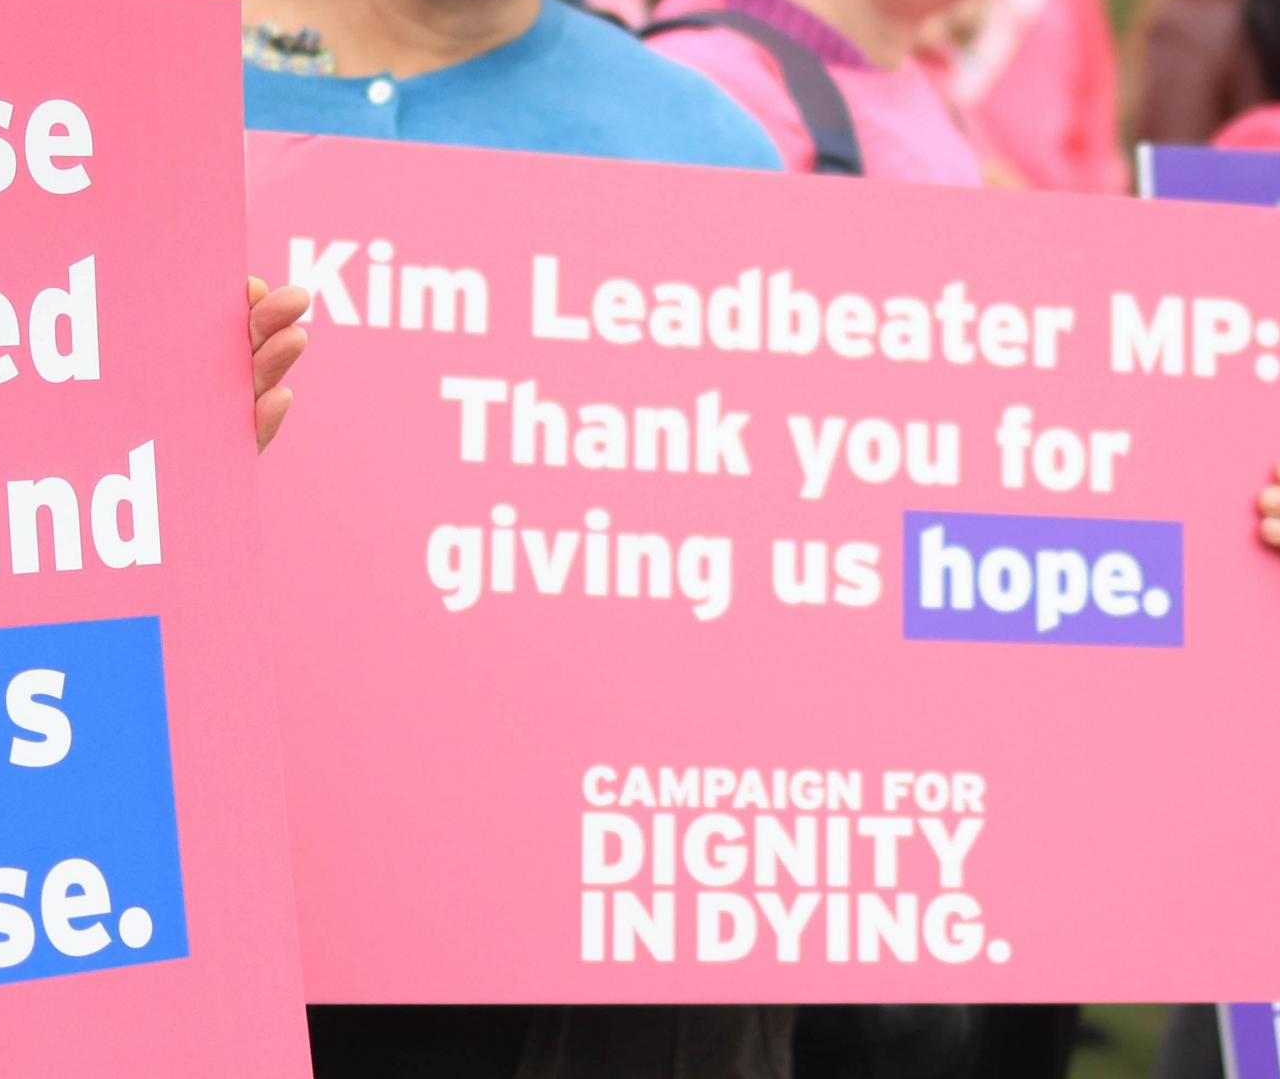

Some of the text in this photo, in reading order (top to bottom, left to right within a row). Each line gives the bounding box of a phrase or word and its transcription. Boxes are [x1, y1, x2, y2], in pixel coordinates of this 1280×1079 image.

[283, 238, 489, 333] Kim
[533, 255, 1074, 369] Leadbeater
[1111, 292, 1280, 381] MP:
[441, 377, 1131, 499] Thank you for
[426, 504, 1171, 632] giving us hope.
[582, 765, 985, 813] CAMPAIGN FOR
[582, 812, 985, 888] DIGNITY
[582, 890, 1011, 964] IN DYING.
